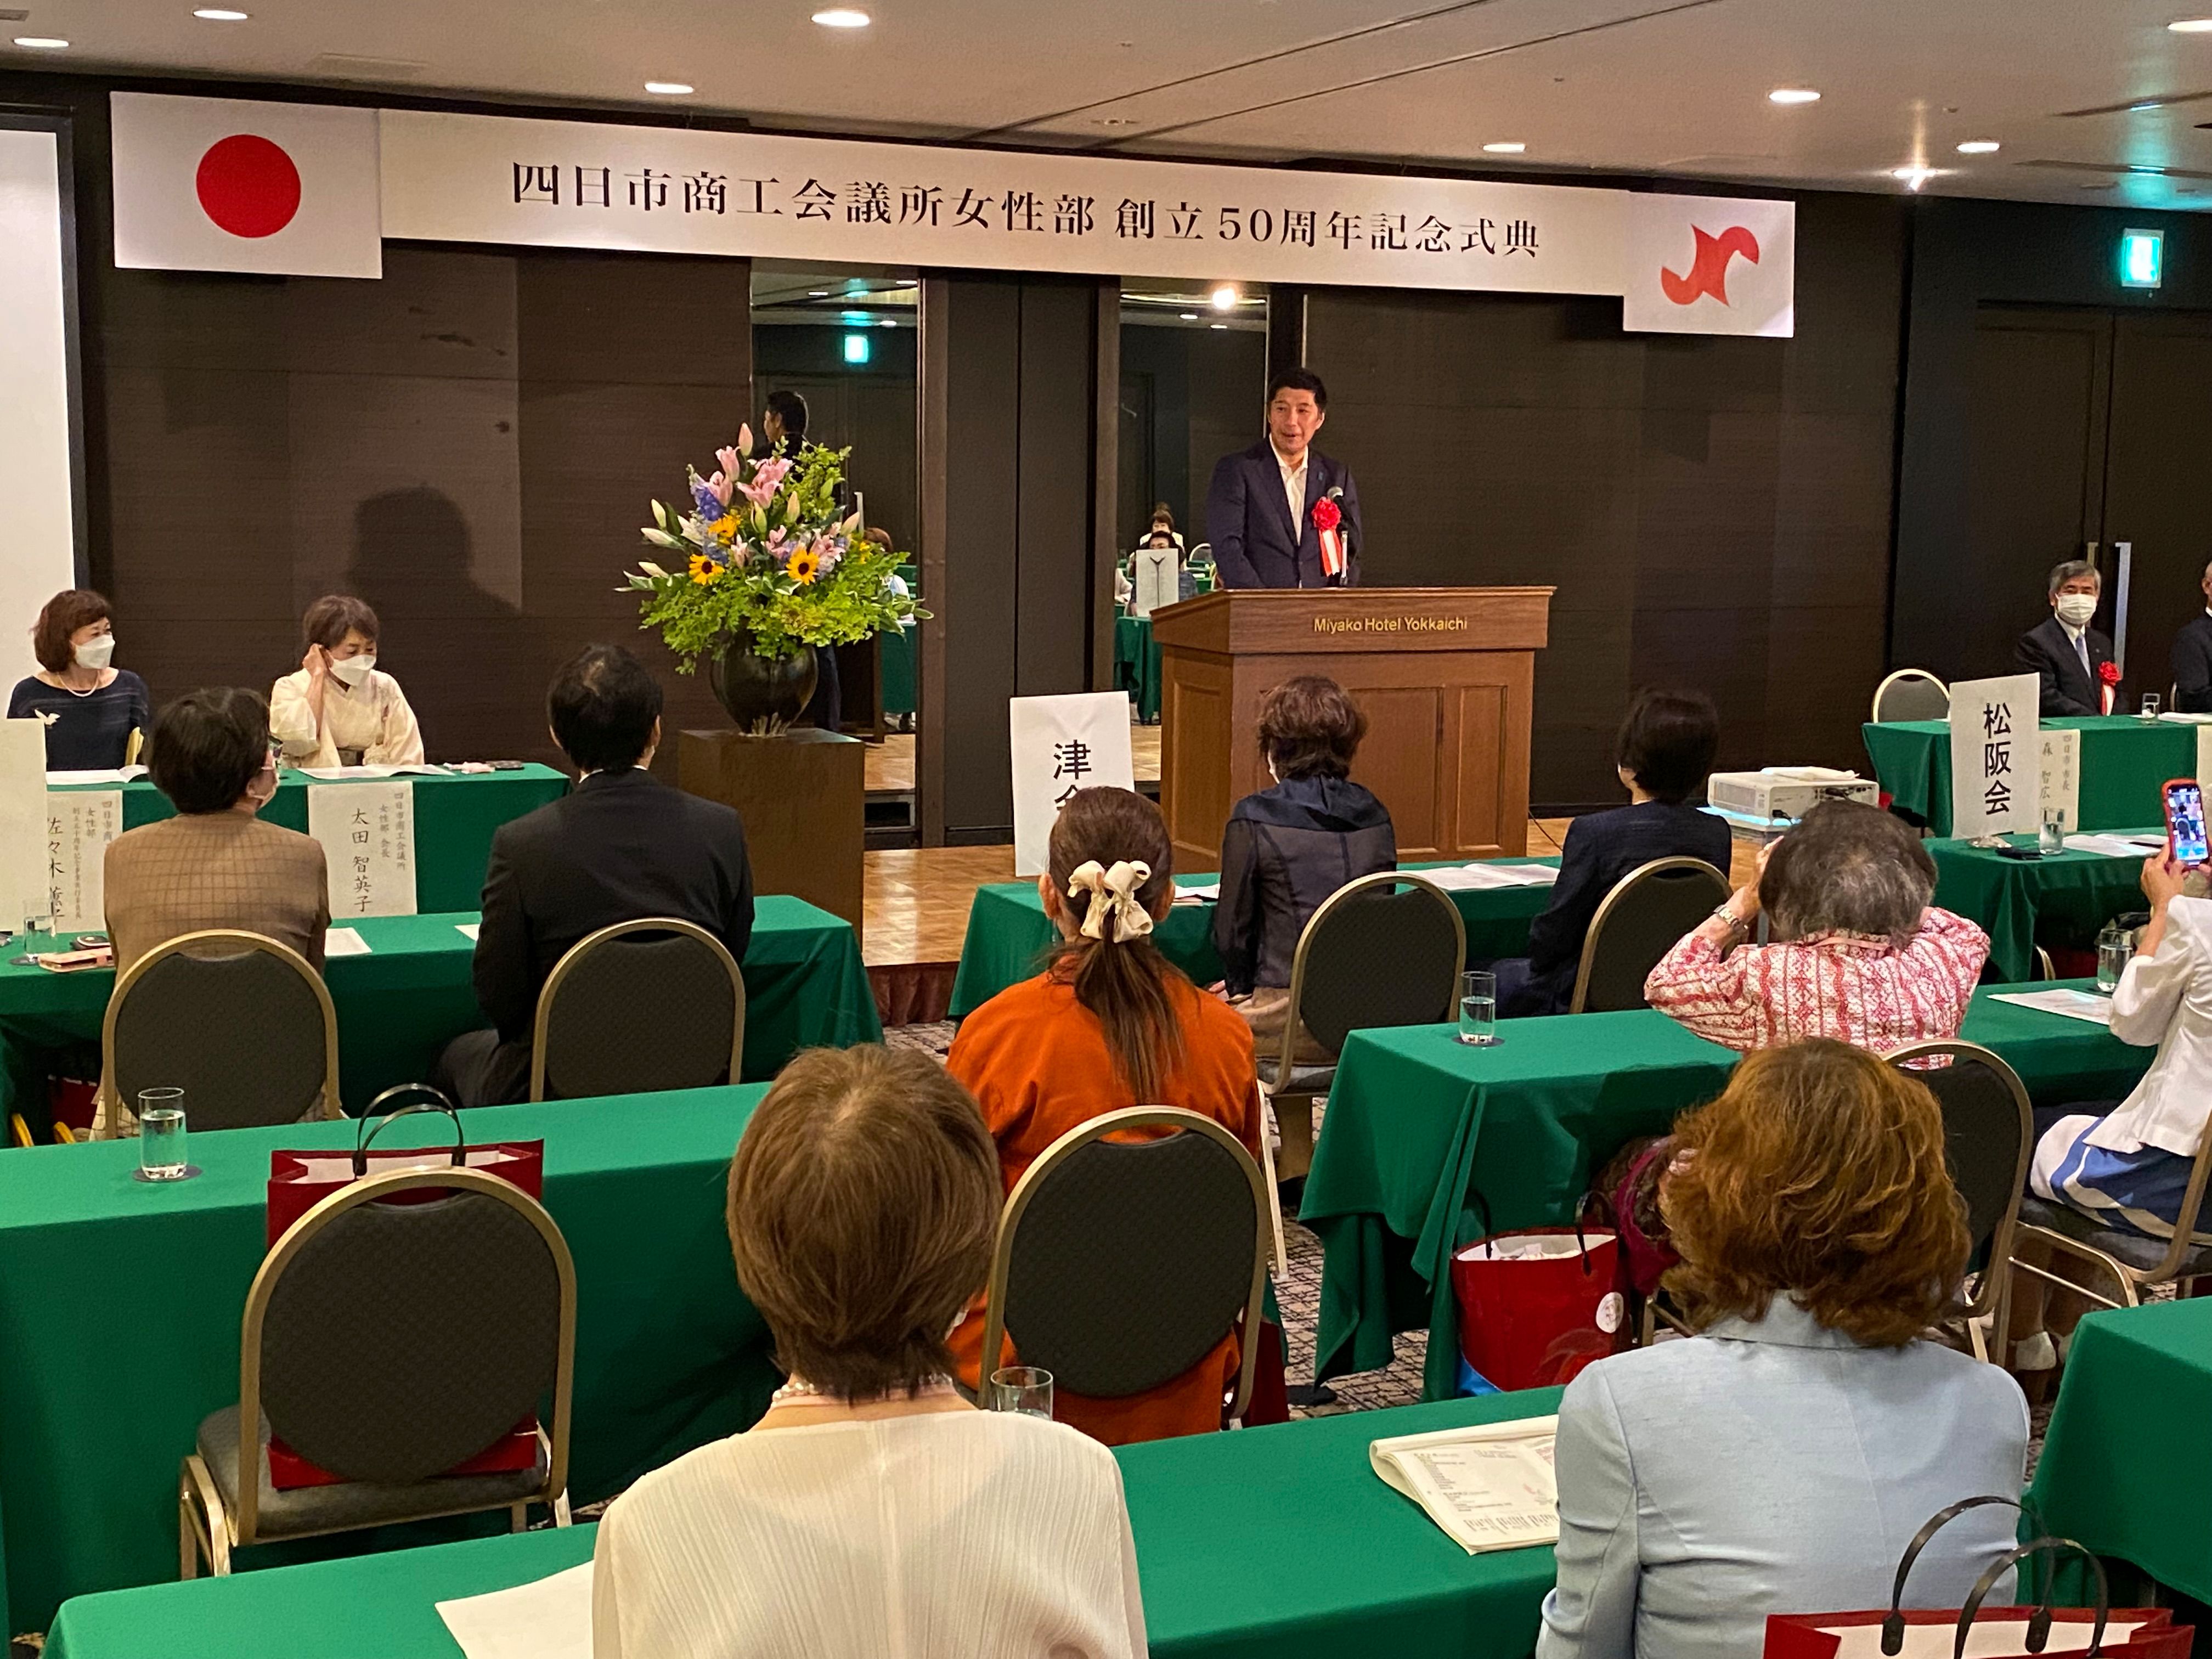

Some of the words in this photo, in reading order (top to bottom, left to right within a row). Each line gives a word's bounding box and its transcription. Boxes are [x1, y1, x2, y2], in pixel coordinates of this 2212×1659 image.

[513, 162, 1095, 235] 四日市商工会議所女性部
[1115, 198, 1539, 258] 創立50周年記念式典
[1314, 618, 1362, 634] Miyako
[1364, 617, 1401, 631] Hotel
[1404, 617, 1468, 631] Yokkaichi
[1053, 739, 1092, 811] 津
[1983, 702, 2012, 816] 松阪会
[351, 808, 370, 844] 太田
[352, 855, 373, 912] 智英子
